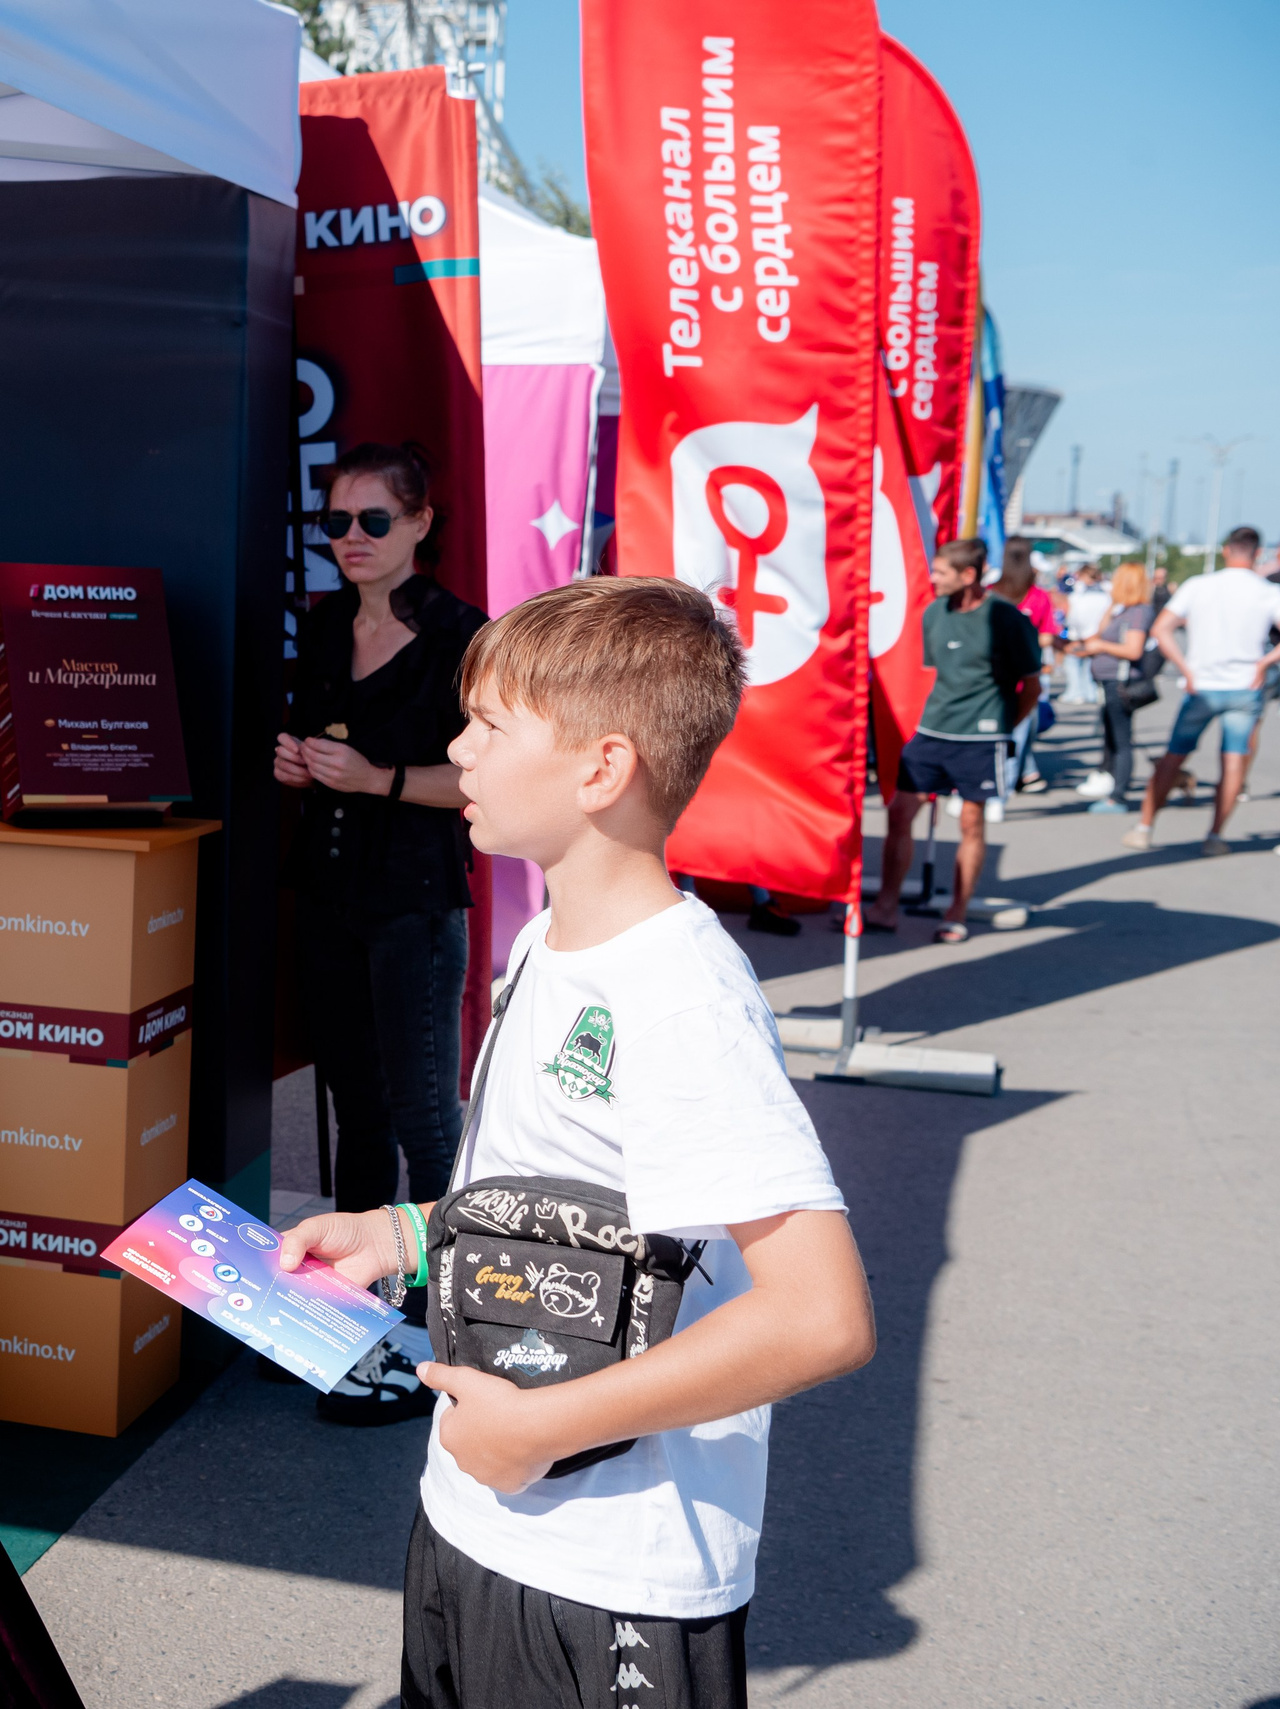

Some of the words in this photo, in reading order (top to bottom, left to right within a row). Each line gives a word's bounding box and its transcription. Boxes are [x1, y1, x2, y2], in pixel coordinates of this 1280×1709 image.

[699, 36, 741, 274] большим
[304, 194, 447, 250] КИНО
[747, 125, 799, 343] сердцем
[660, 106, 703, 378] Телеканал
[711, 285, 743, 312] с
[912, 261, 939, 420] сердцем
[43, 584, 84, 601] ДОМ
[87, 585, 137, 602] КИНО
[28, 670, 40, 684] и
[45, 667, 157, 689] Маргарита
[62, 659, 118, 675] Мастер
[58, 719, 99, 730] Михаил
[101, 719, 149, 731] Булгаков
[38, 1022, 104, 1047] КИНО
[32, 1231, 97, 1257] КИНО
[475, 1265, 524, 1292] Gang
[495, 1283, 536, 1305] bear
[217, 1307, 328, 1378] Квест-карта
[493, 1349, 568, 1372] Краснодар
